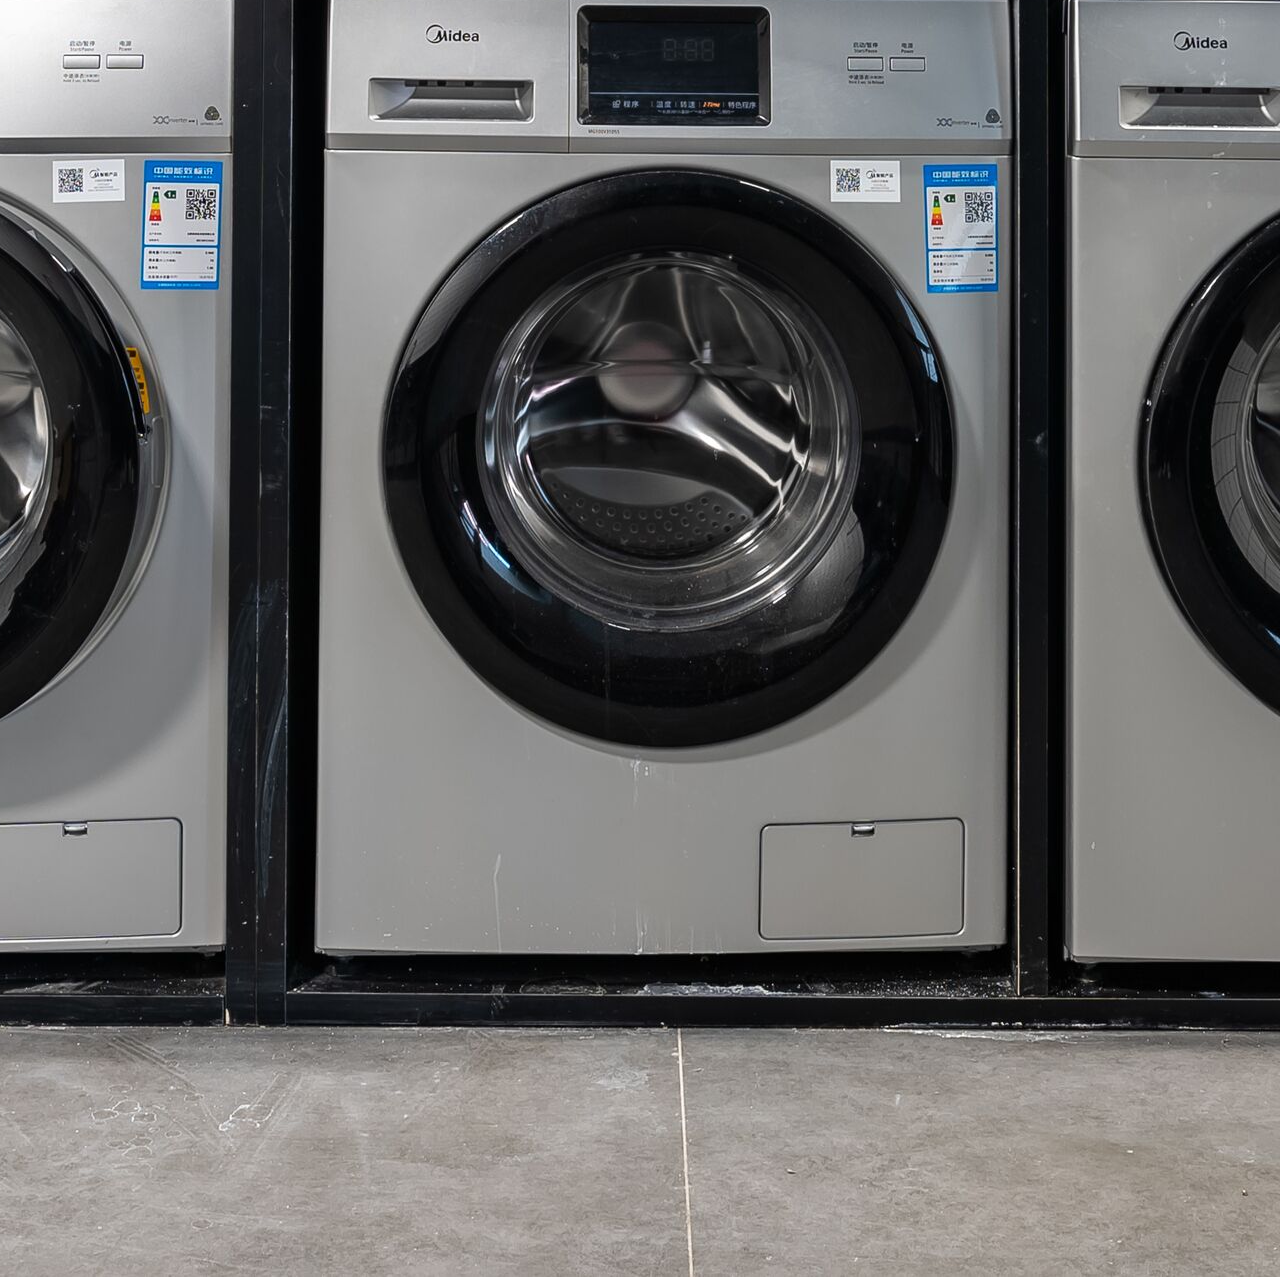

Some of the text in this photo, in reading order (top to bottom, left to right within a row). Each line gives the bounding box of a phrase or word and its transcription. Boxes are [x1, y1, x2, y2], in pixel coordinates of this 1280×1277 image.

[426, 24, 480, 44] Midea
[1174, 31, 1228, 51] Midea
[623, 100, 639, 108] 程序
[656, 100, 671, 108] 温度
[728, 101, 757, 109] 特色程序
[153, 167, 213, 175] 中国能效标识
